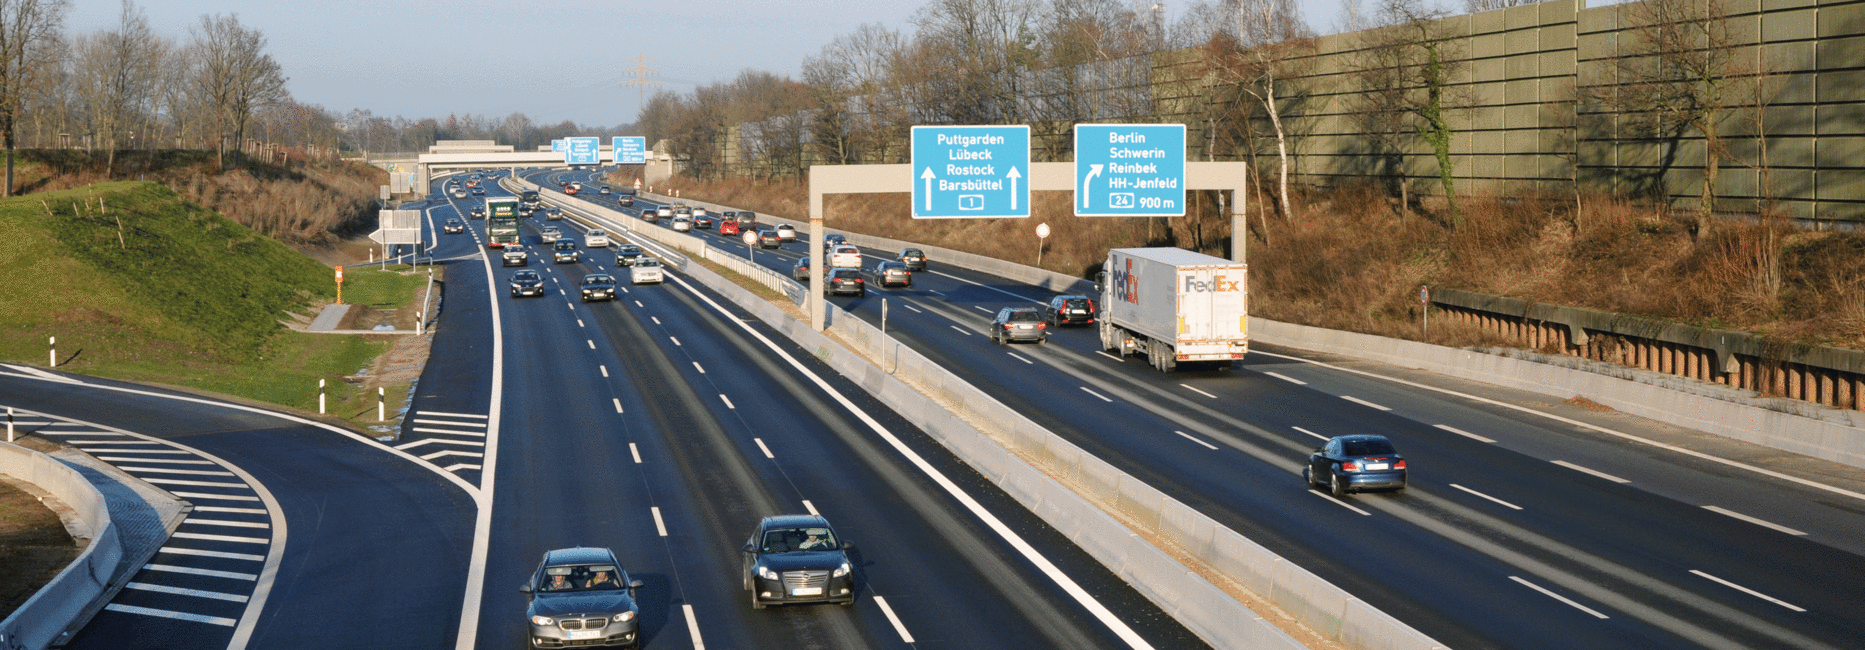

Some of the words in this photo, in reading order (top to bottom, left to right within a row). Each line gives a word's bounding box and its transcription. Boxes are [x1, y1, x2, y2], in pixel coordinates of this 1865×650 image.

[937, 133, 1004, 147] Puttgarden
[1109, 132, 1146, 143] Berlin
[949, 148, 993, 160] Lübeck
[1109, 147, 1165, 158] Schwerin
[946, 164, 995, 175] Rostock
[1109, 162, 1157, 174] Reinbek
[939, 179, 1003, 191] Barsbüttel
[1109, 177, 1177, 189] HH-Jenfeld
[1115, 195, 1128, 205] 24
[1139, 197, 1161, 209] 900
[1163, 199, 1174, 209] m
[1112, 254, 1139, 306] FedEx
[1185, 275, 1239, 292] FedEx
